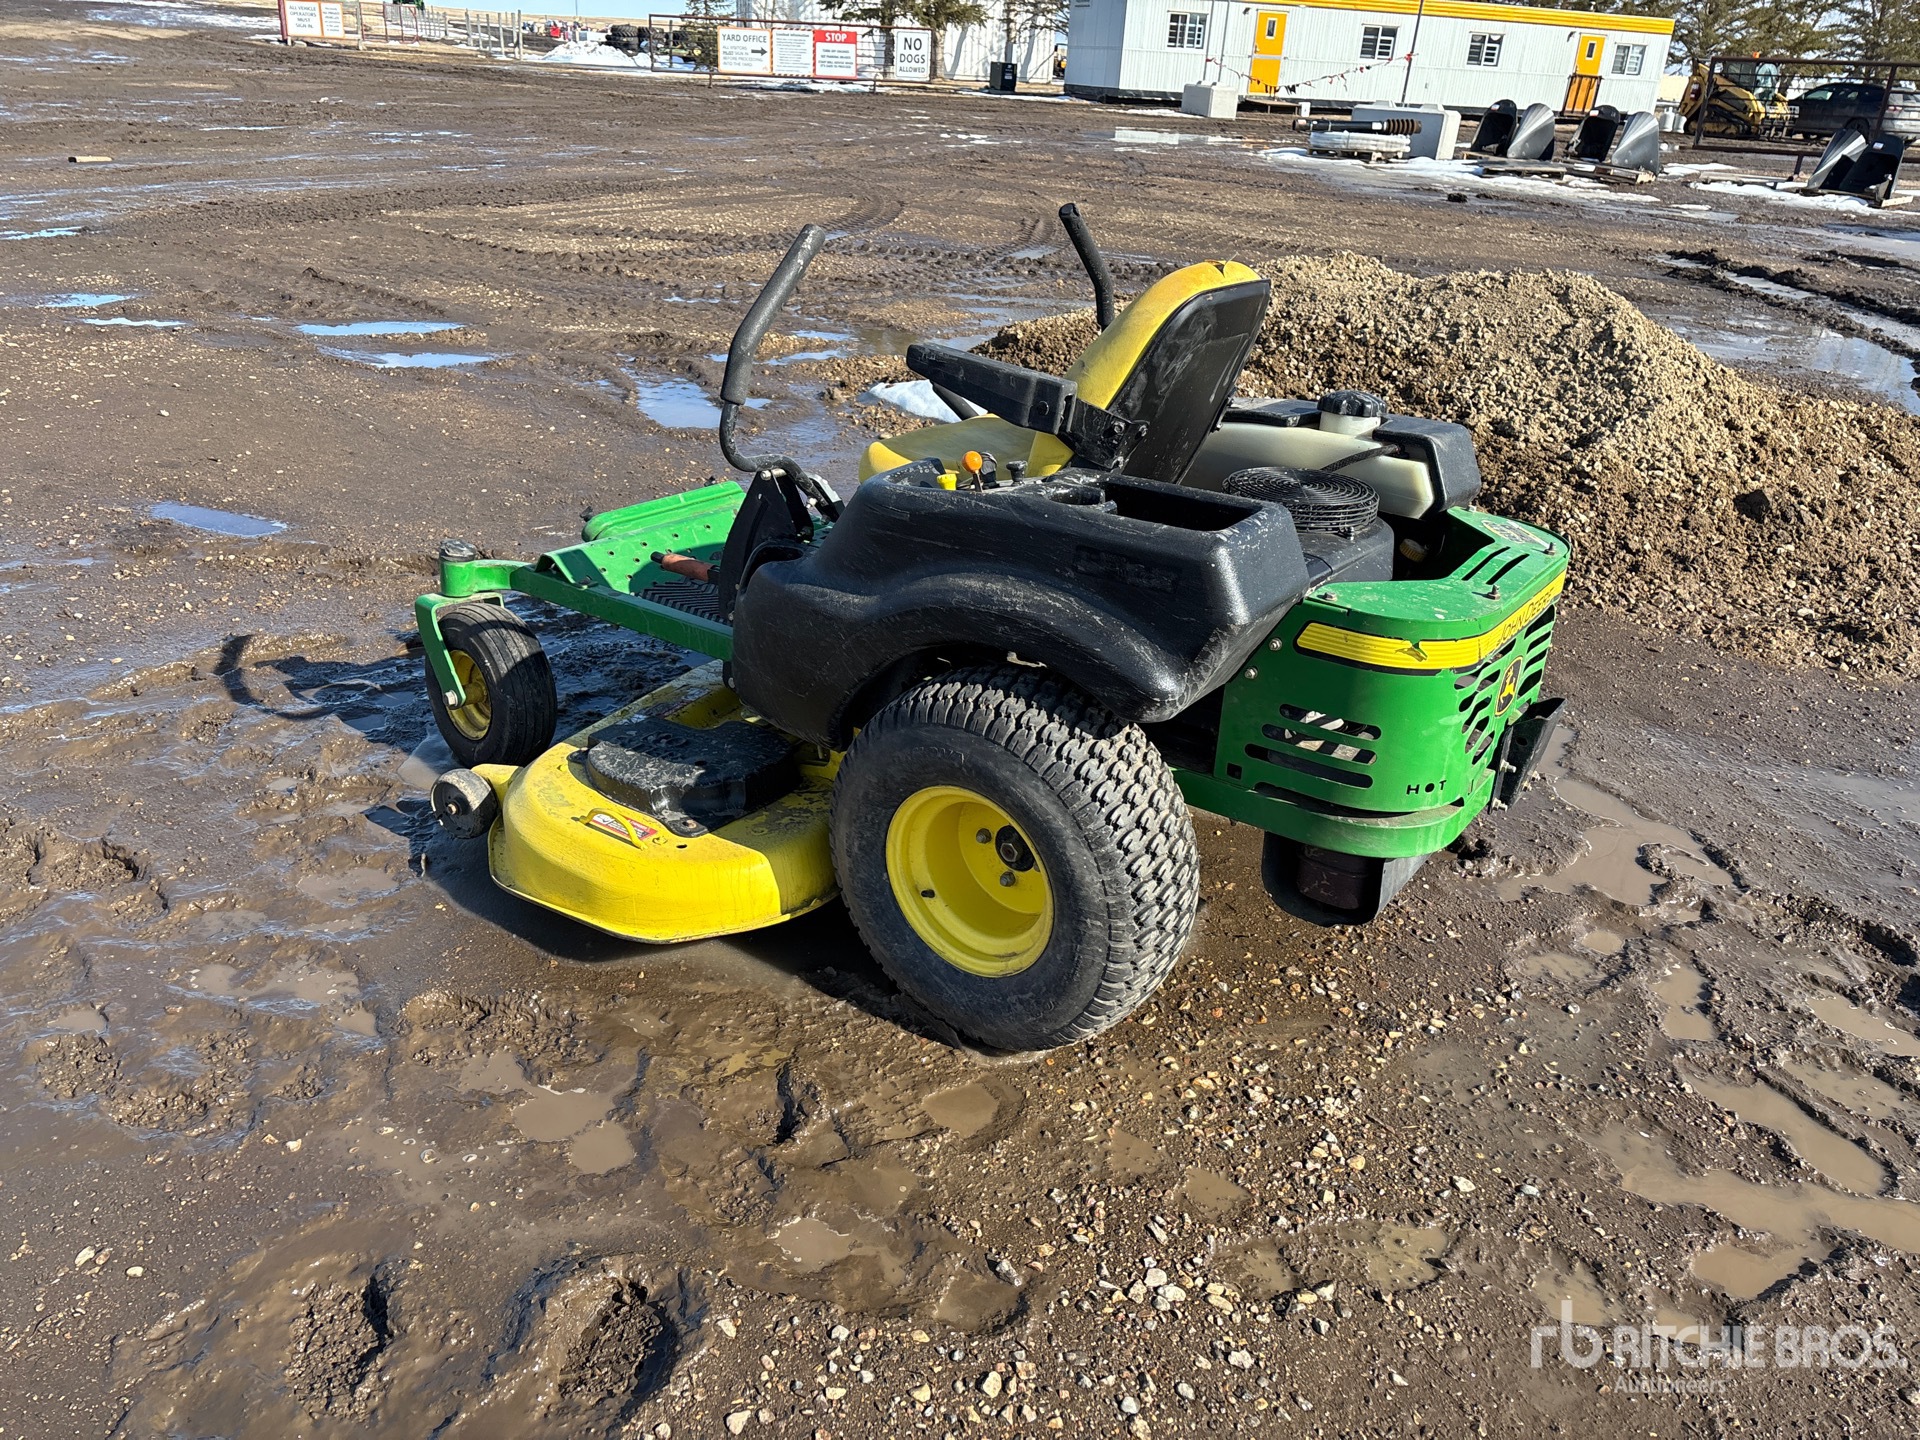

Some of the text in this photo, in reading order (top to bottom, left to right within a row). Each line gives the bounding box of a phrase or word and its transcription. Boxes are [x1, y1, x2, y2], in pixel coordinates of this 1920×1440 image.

[722, 34, 741, 42] YARD
[743, 34, 767, 43] OFFICE
[825, 32, 847, 42] STOP
[903, 37, 922, 50] NO
[900, 53, 926, 64] DOGS
[1406, 779, 1447, 796] HOT
